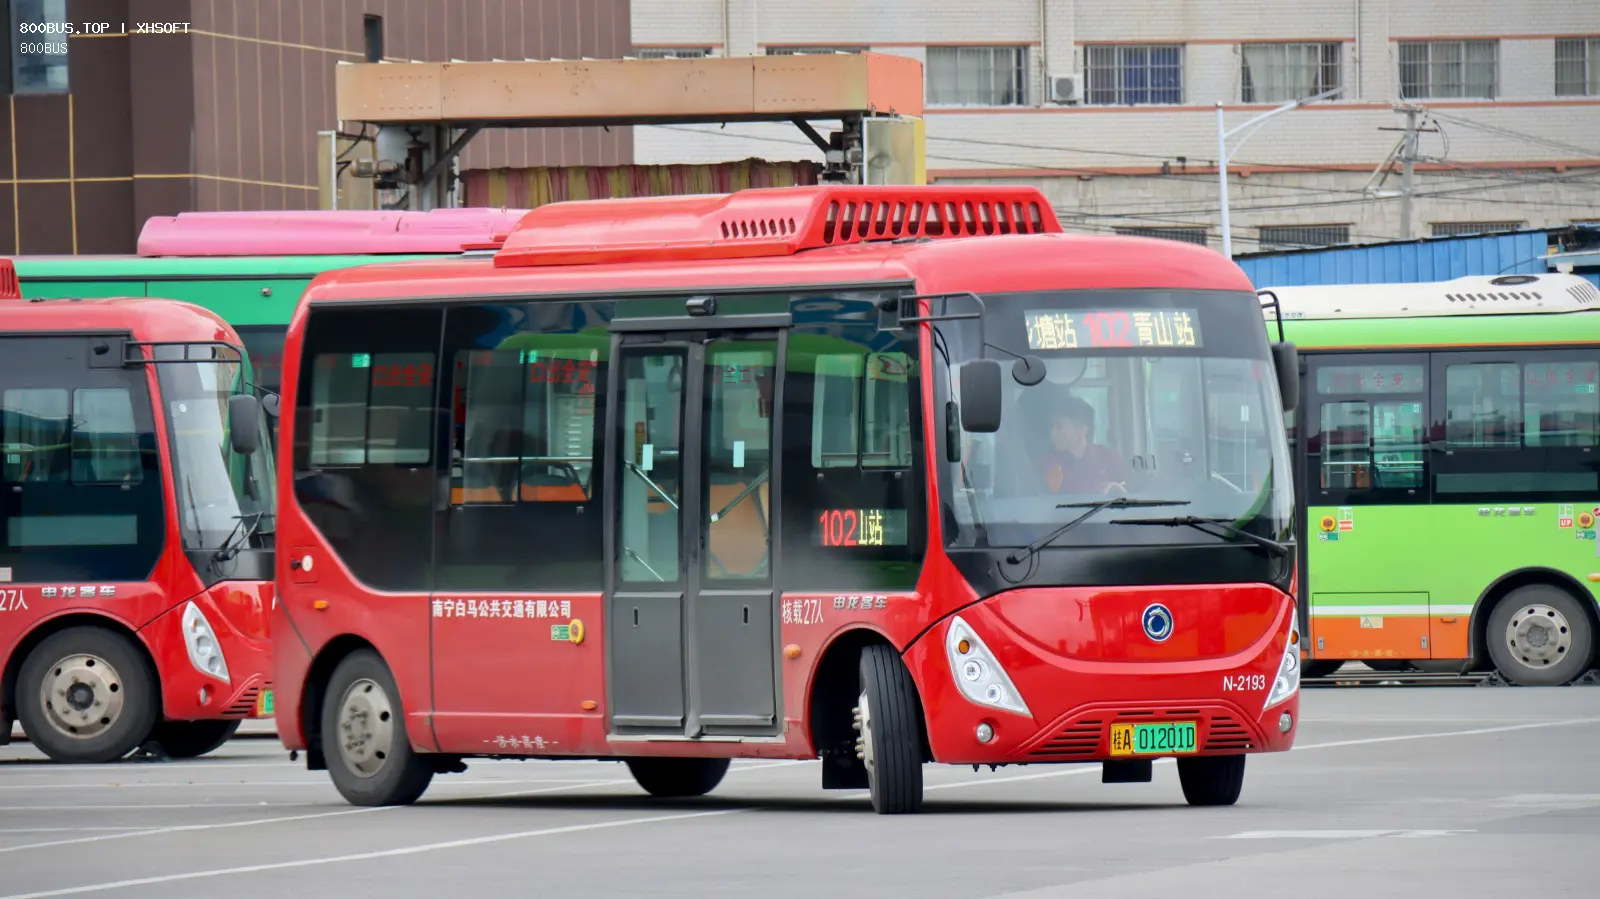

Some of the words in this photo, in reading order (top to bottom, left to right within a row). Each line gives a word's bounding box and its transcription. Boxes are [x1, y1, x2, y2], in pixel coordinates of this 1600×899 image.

[1026, 313, 1078, 349] 塘站
[1083, 312, 1134, 347] 102
[1133, 312, 1195, 346] 青山站
[820, 509, 857, 546] 102
[1560, 519, 1572, 527] UP
[432, 599, 571, 618] 南宁白马公共交通有限公司
[782, 599, 824, 625] 核载27人
[1223, 675, 1265, 691] N-2193
[1113, 729, 1131, 750] 桂A
[1139, 726, 1195, 749] 01201D
